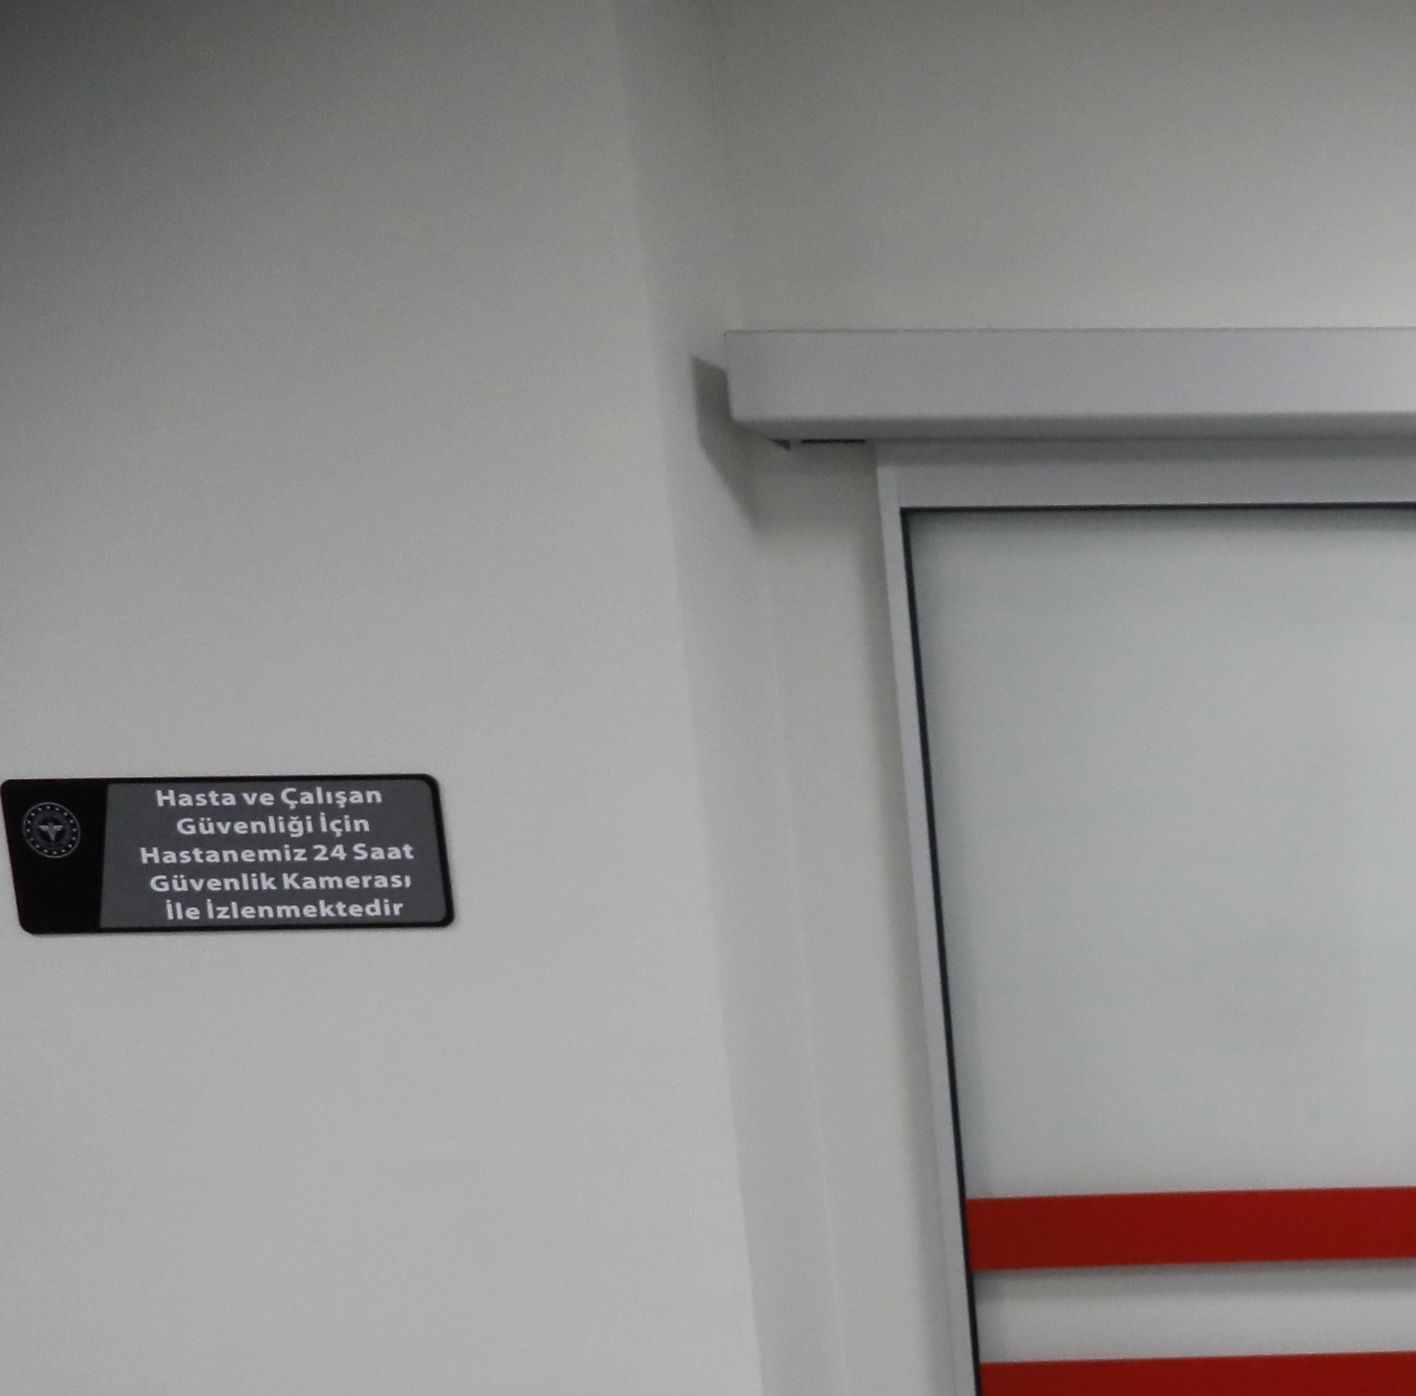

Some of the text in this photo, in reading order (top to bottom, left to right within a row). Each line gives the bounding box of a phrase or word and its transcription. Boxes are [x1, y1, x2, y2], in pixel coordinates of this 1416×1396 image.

[156, 786, 382, 810] Hasta ve Çalışan
[176, 811, 370, 838] Güvenliği İçin
[140, 843, 414, 864] Hastanemiz 24 Saat
[149, 872, 412, 893] Güvenlik Kamerası
[166, 898, 404, 920] İle İzlenmektedir
